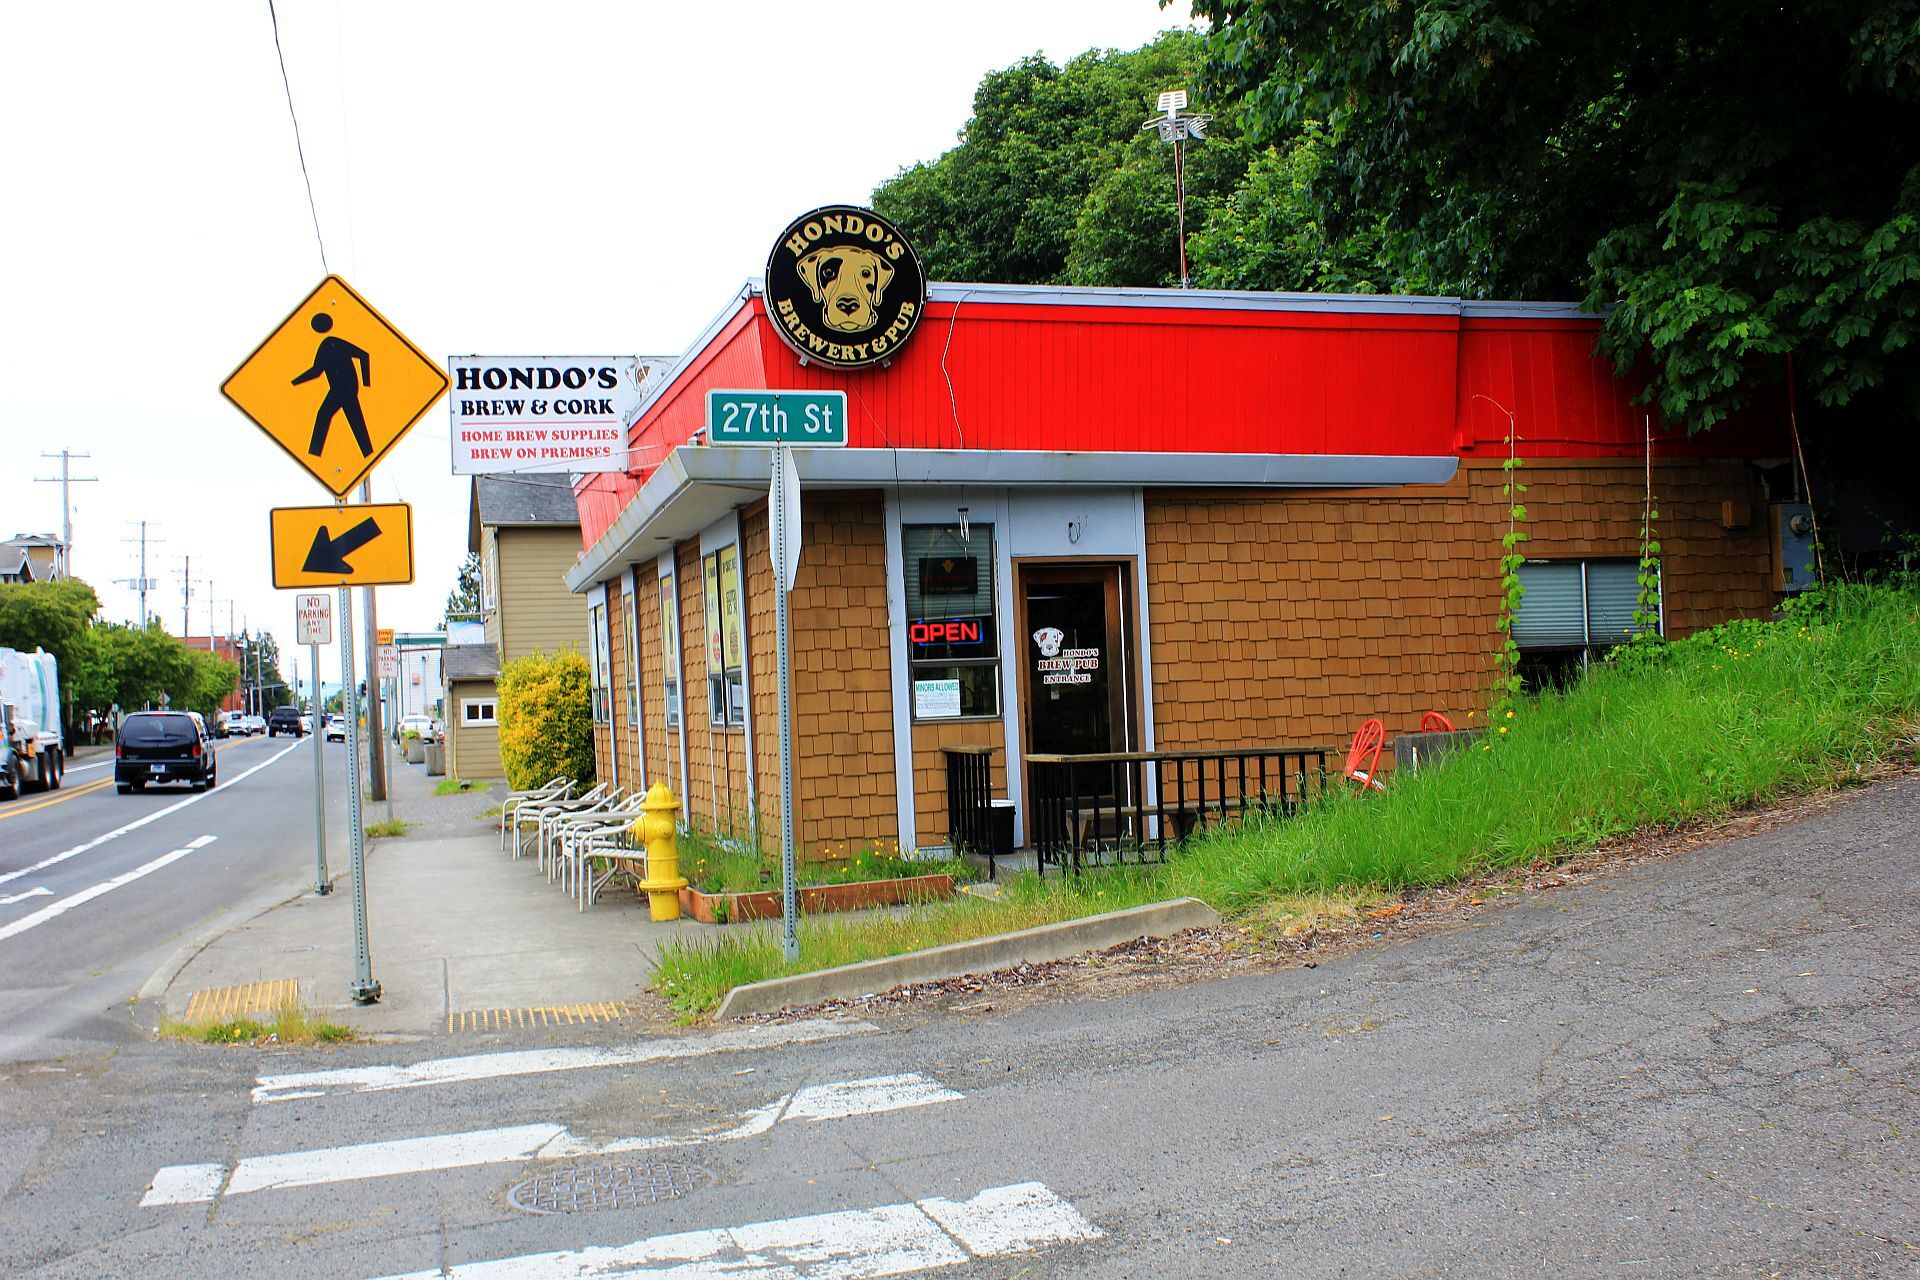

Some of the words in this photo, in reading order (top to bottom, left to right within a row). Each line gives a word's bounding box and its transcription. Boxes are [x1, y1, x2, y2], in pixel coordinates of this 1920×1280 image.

[785, 215, 905, 261] HONDO'S
[777, 298, 869, 361] BREWERY
[871, 335, 888, 353] &
[889, 301, 915, 344] PUB
[456, 367, 618, 390] HONDO'S
[461, 399, 525, 416] BREW
[531, 399, 548, 415] &
[553, 398, 615, 415] CORK
[722, 402, 788, 433] 27th
[804, 403, 833, 433] St
[461, 430, 503, 442] HOME
[506, 429, 548, 441] BREW
[551, 429, 619, 441] SUPPLIES
[471, 447, 514, 459] BREW
[516, 447, 537, 459] ON
[541, 446, 611, 458] PREMISES
[307, 598, 320, 608] NO
[298, 609, 329, 619] PARKING
[910, 622, 978, 643] OPEN
[1063, 649, 1099, 657] HONDO'S
[1038, 659, 1072, 670] BREW
[1074, 659, 1098, 669] PUB
[1044, 674, 1091, 684] ENTRANCE
[916, 683, 935, 692] MINORS
[935, 682, 958, 692] ALLOWED
